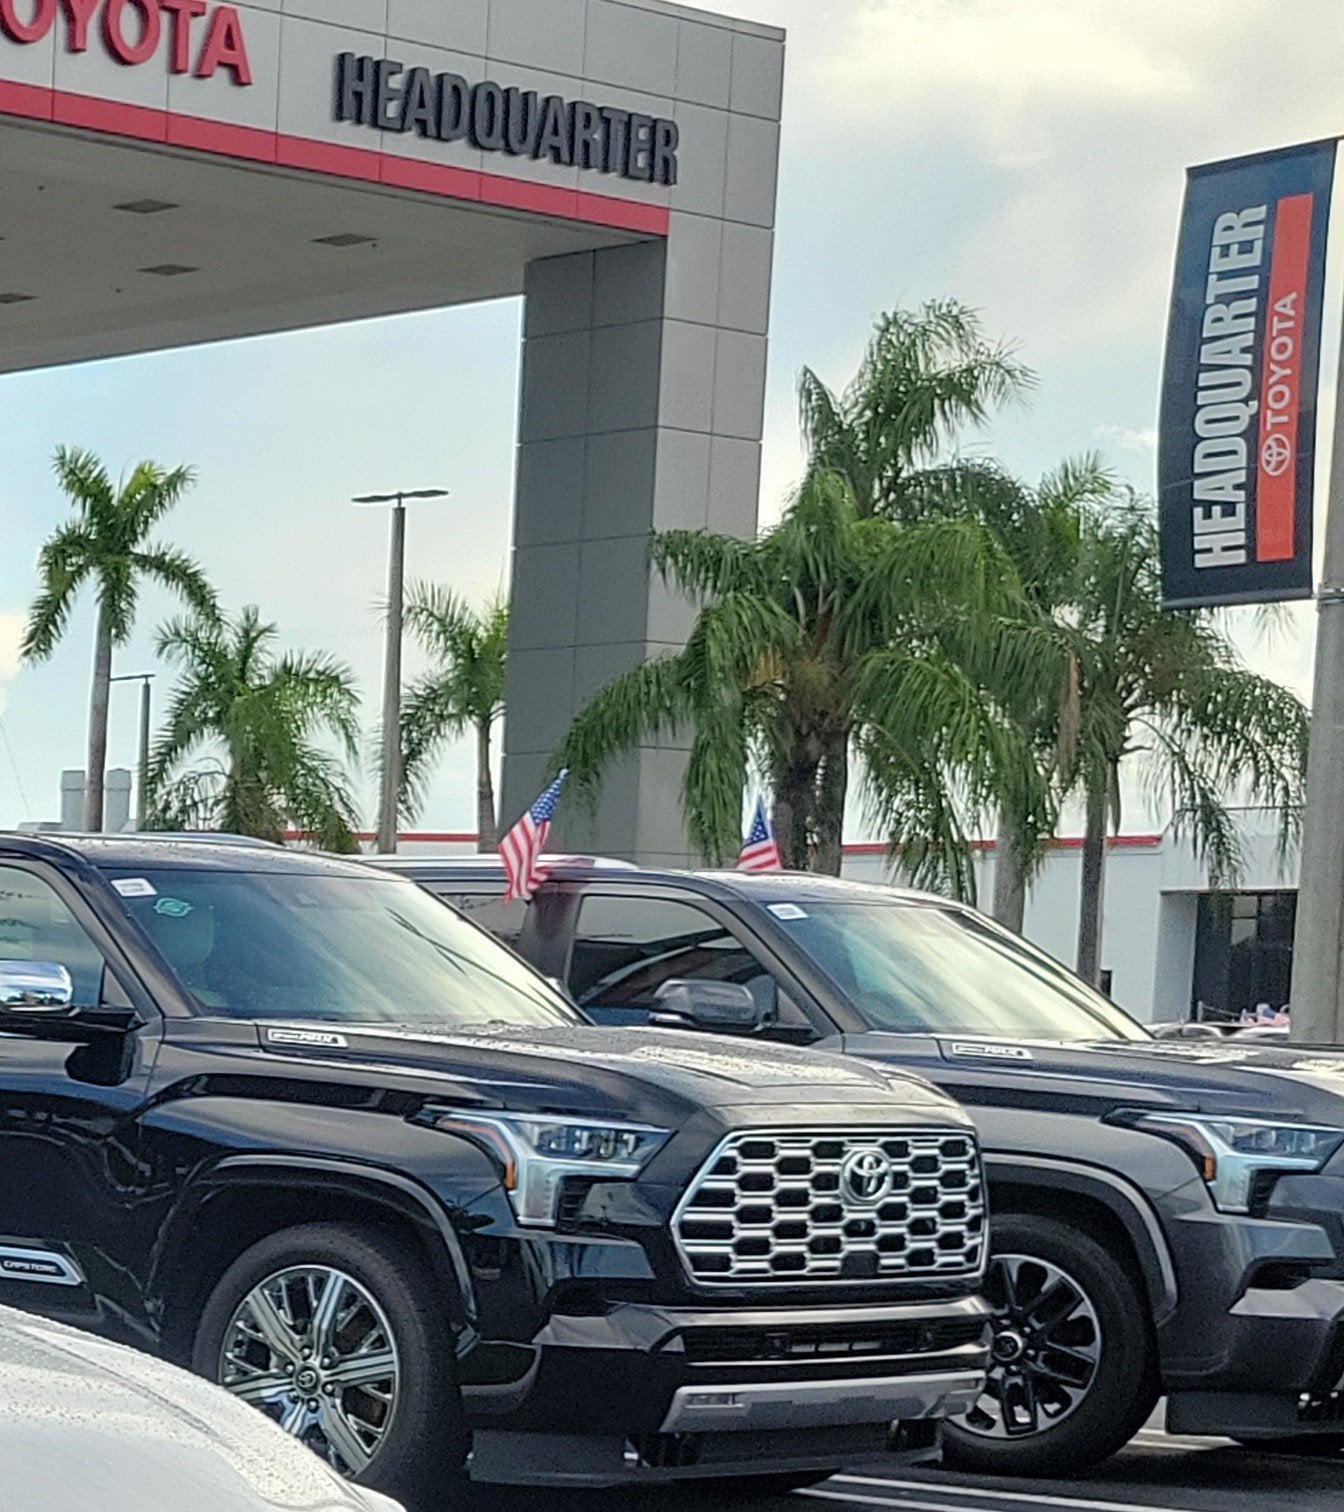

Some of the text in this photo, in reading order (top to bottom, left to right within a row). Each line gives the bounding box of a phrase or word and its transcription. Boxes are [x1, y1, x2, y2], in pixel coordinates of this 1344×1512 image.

[335, 52, 679, 186] HEADQUARTER
[1193, 204, 1268, 569] HEADQUARTER
[1265, 291, 1298, 431] TOYOTA
